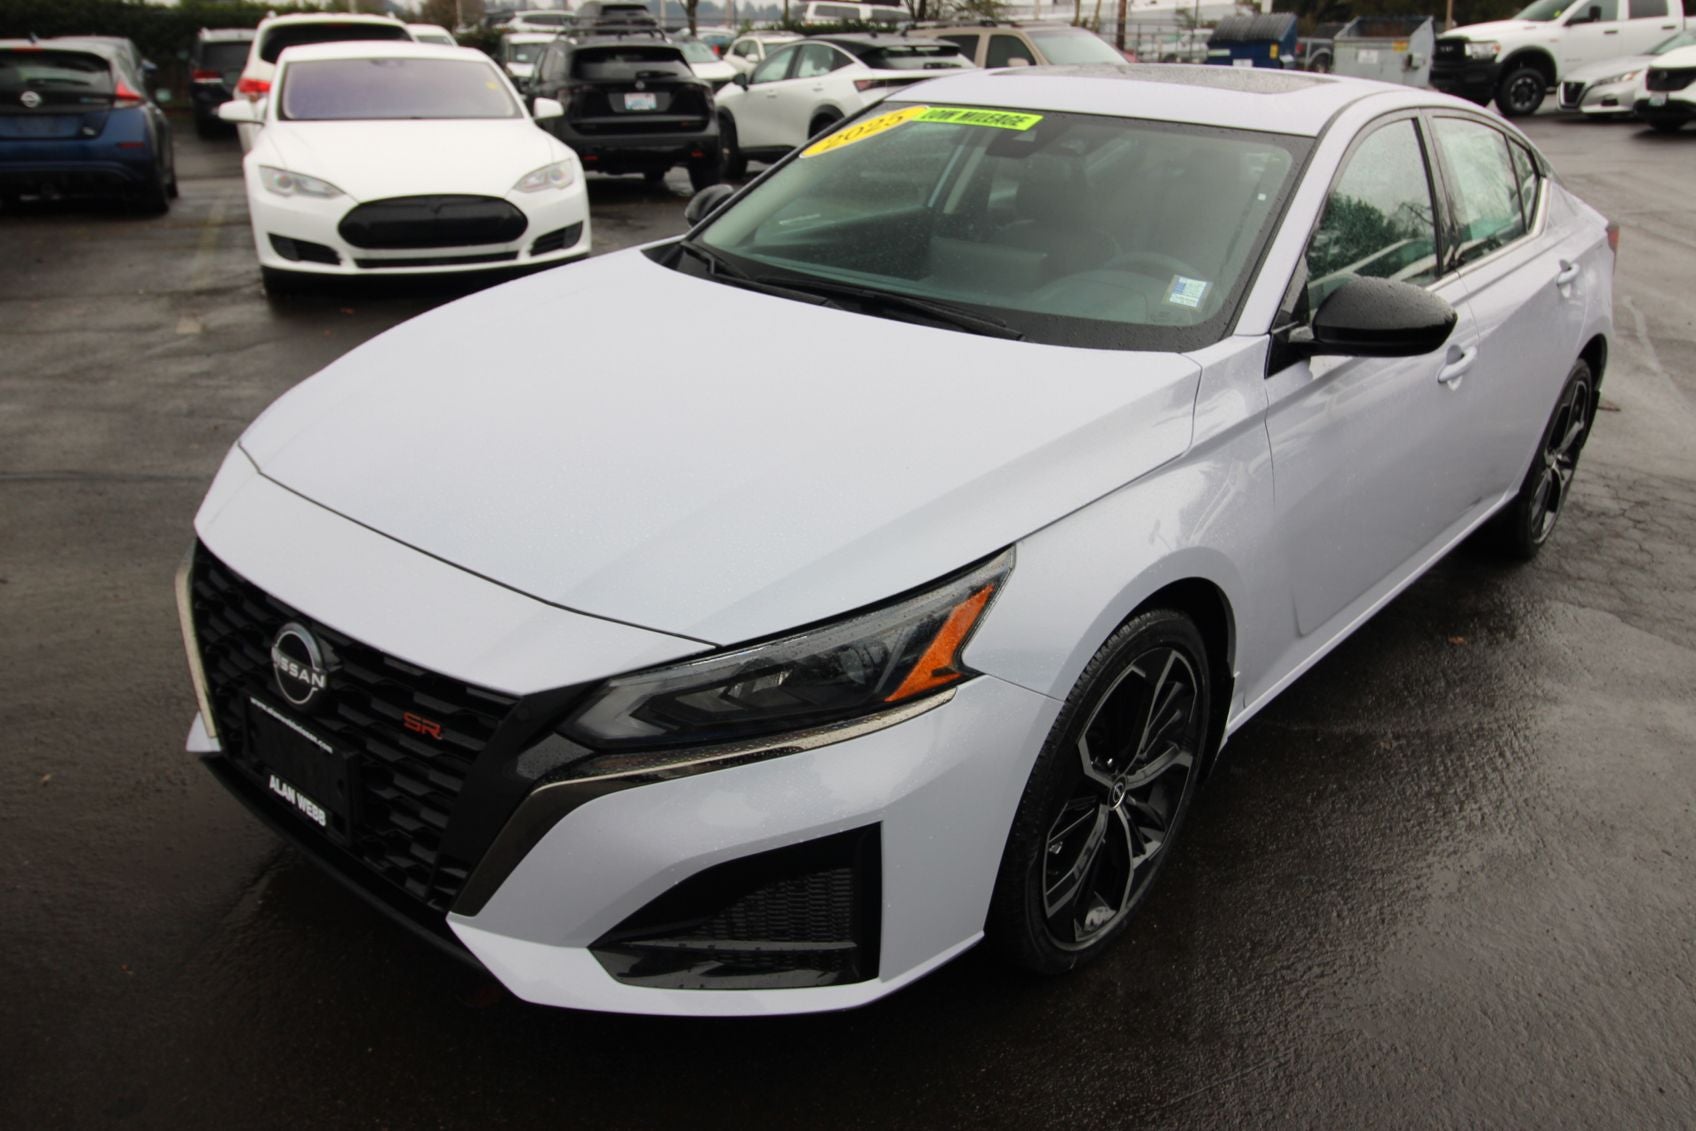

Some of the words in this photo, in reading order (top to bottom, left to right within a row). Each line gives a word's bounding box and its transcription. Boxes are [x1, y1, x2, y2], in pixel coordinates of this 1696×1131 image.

[955, 111, 1032, 127] MILEAGE
[403, 711, 443, 740] SR
[269, 774, 296, 805] ALAN
[296, 792, 327, 827] WEBB
